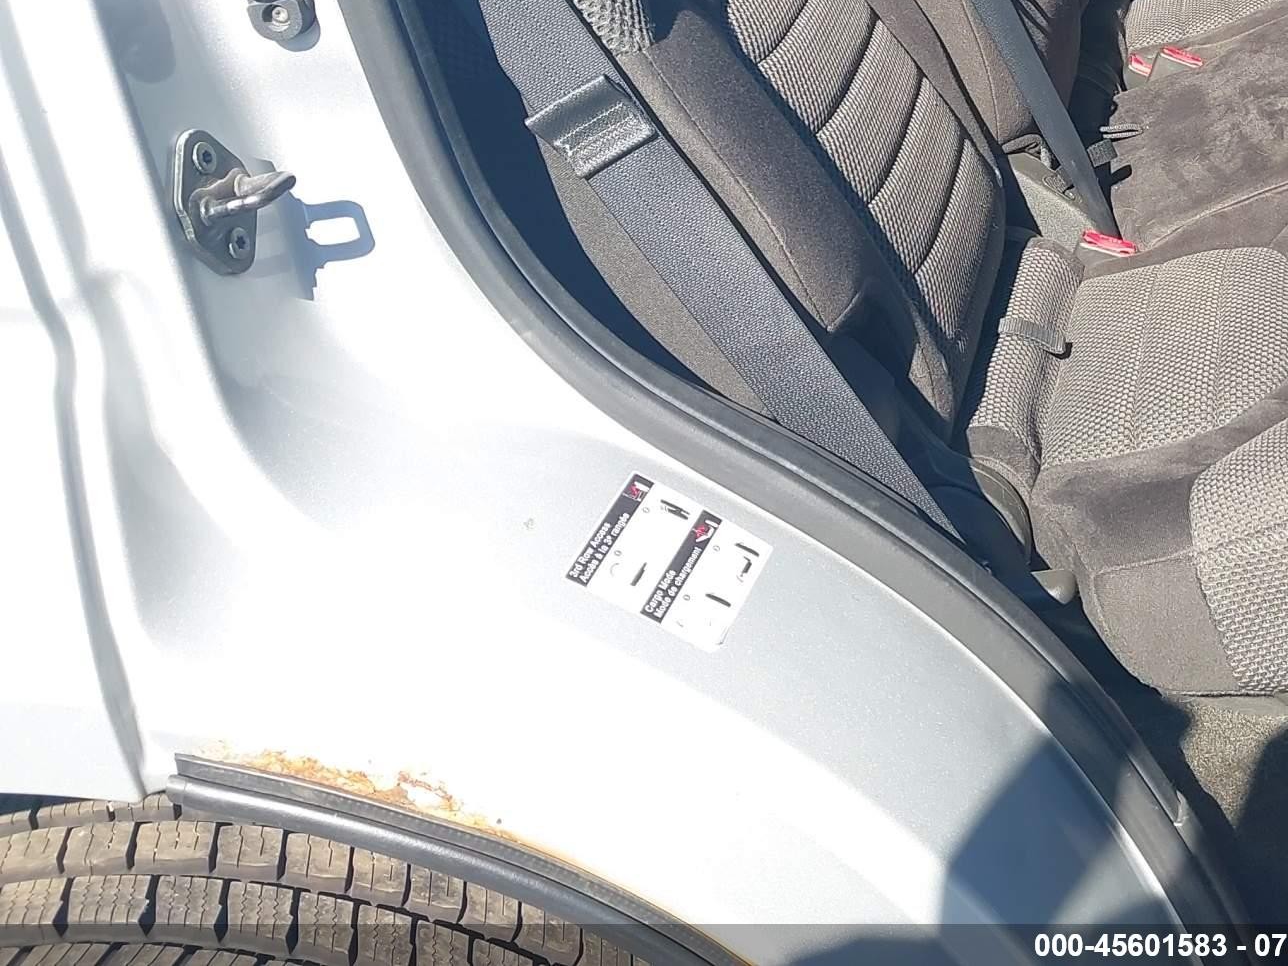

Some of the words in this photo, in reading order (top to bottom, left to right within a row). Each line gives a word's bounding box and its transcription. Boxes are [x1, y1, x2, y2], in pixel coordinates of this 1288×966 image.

[569, 562, 583, 578] 3rd
[577, 546, 594, 564] Row
[589, 522, 611, 548] Access
[598, 543, 609, 554] la
[644, 589, 664, 613] Cargo
[658, 569, 676, 590] Mode
[653, 596, 672, 619] Mode
[667, 586, 678, 597] de
[674, 546, 702, 586] chargement
